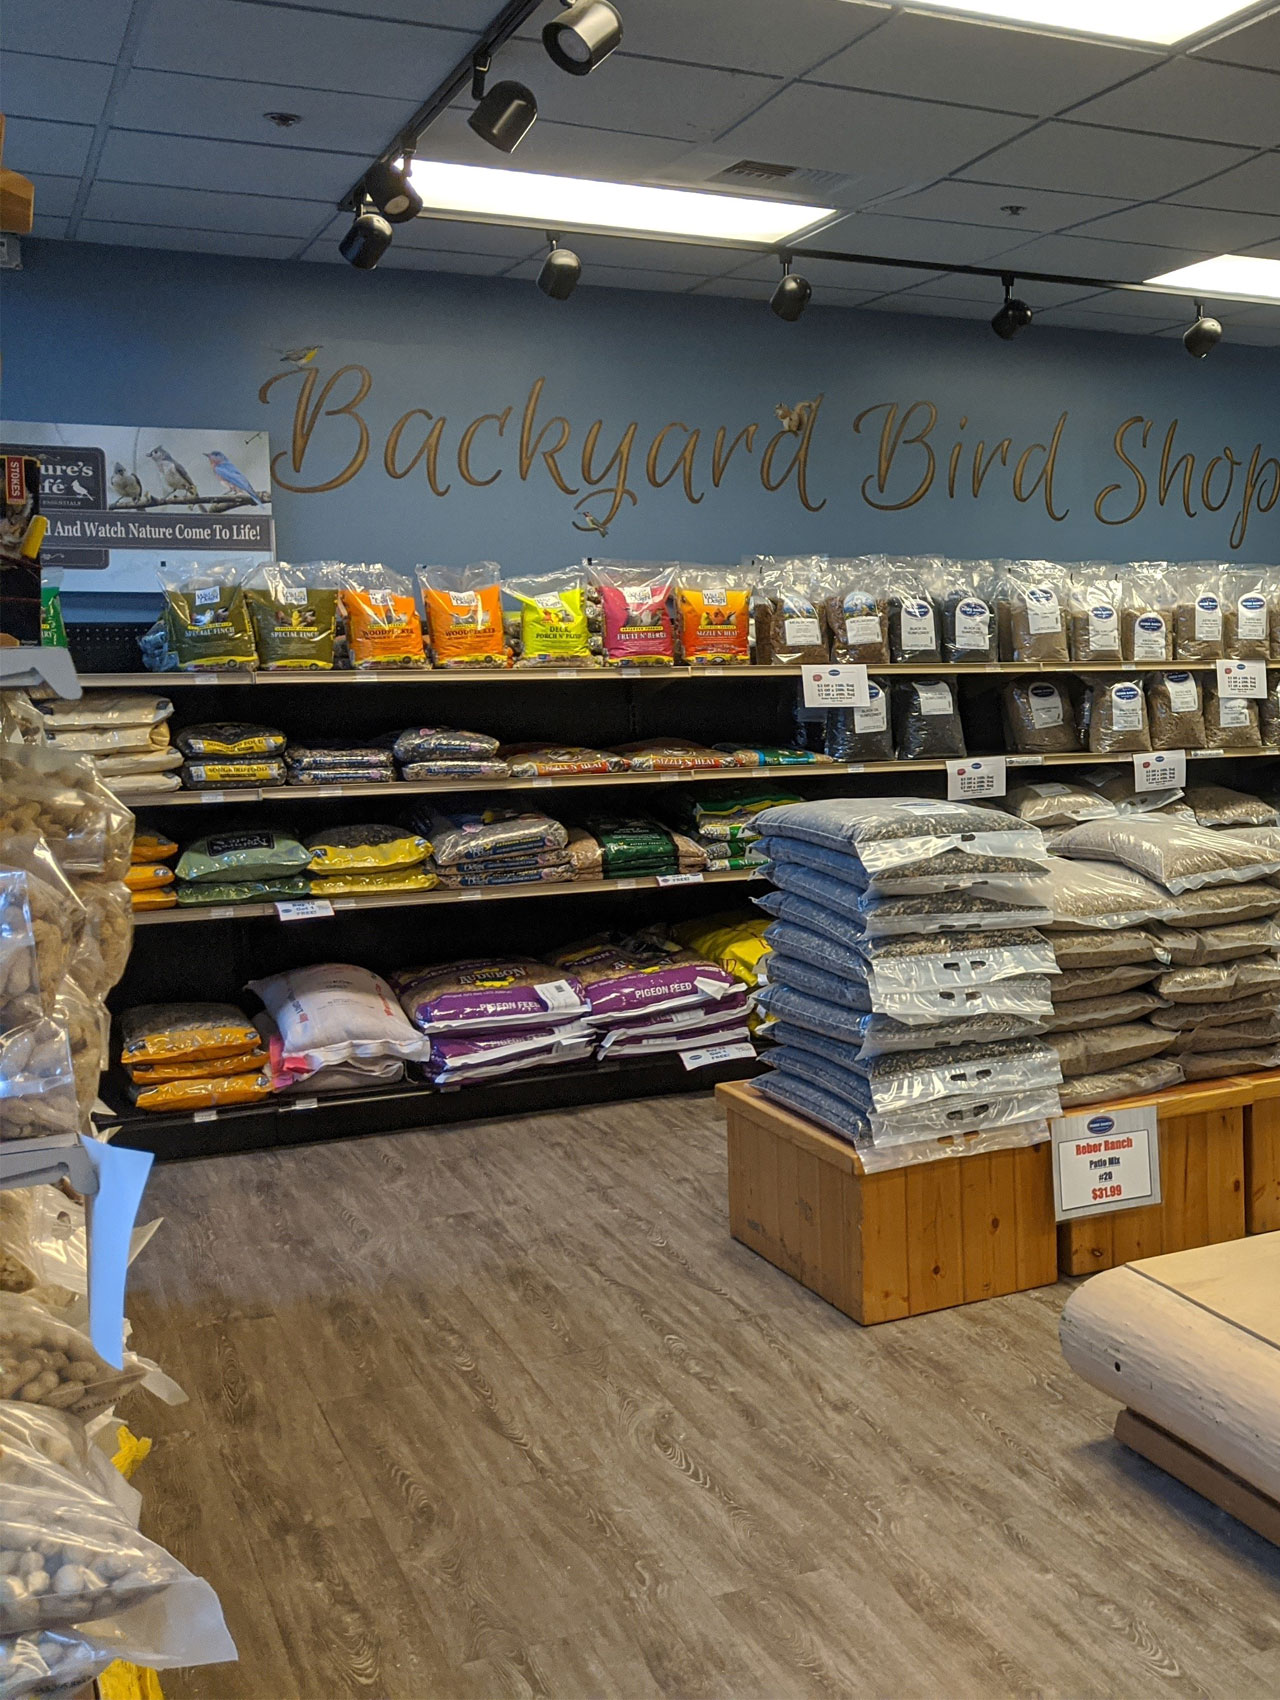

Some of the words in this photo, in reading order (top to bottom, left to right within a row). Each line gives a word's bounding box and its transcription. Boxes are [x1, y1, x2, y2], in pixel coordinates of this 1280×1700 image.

[258, 364, 827, 532] Backyard
[853, 399, 1071, 522] Bird
[40, 462, 94, 477] ure's
[10, 461, 20, 497] STOKES
[54, 520, 82, 537] And
[84, 521, 126, 538] Watch
[128, 522, 173, 540] Nature
[175, 524, 211, 540] Come
[213, 524, 230, 540] To
[232, 524, 261, 541] Life!
[185, 628, 213, 638] SPECIAL
[213, 626, 235, 636] FINCH
[270, 631, 299, 639] SPECIAL
[617, 633, 638, 641] FRUIT
[459, 967, 526, 985] AUDUBON
[635, 988, 669, 999] PIGEON
[670, 982, 692, 993] FEED
[479, 1002, 516, 1012] PIGEON
[1076, 1142, 1102, 1156] Reber
[1104, 1137, 1133, 1151] Ranch
[1089, 1159, 1107, 1169] Patio
[1108, 1156, 1121, 1166] Mix
[1098, 1171, 1113, 1181] #20
[1092, 1184, 1122, 1201] $31.99
